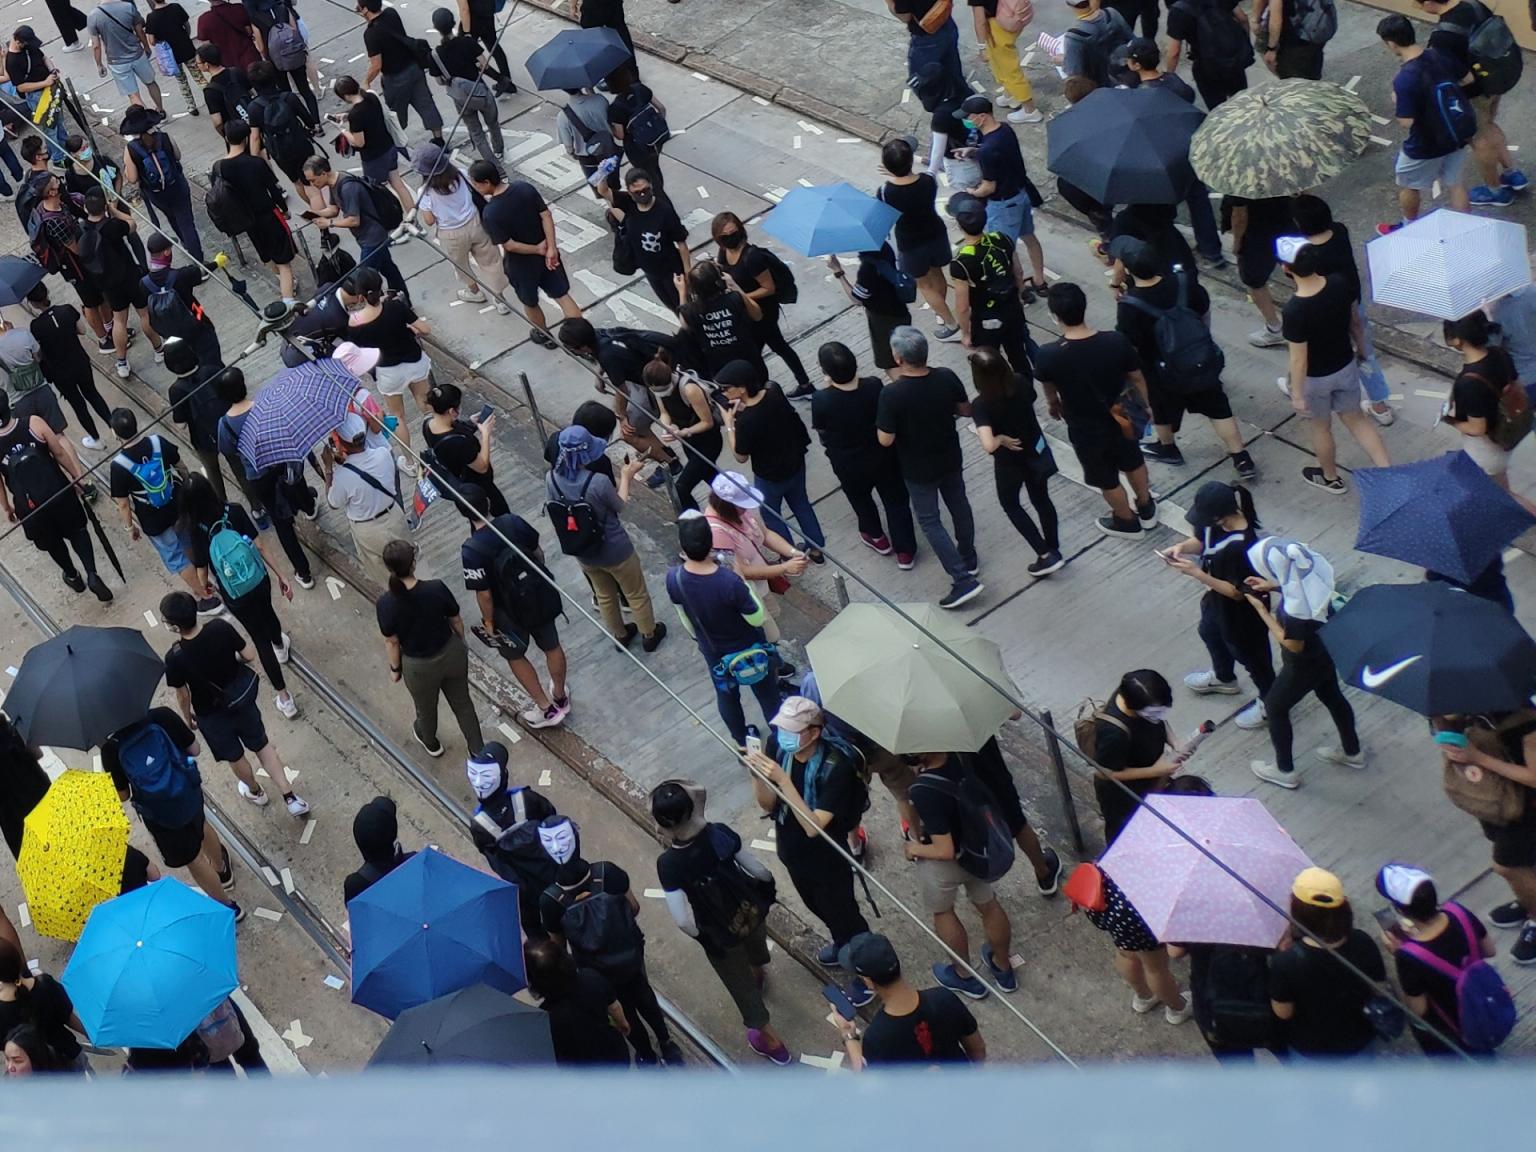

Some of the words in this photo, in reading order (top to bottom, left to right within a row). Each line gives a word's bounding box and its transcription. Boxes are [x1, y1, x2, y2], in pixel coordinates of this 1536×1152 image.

[702, 320, 733, 332] NEVER
[705, 330, 731, 339] WALK
[709, 337, 738, 348] ALONE
